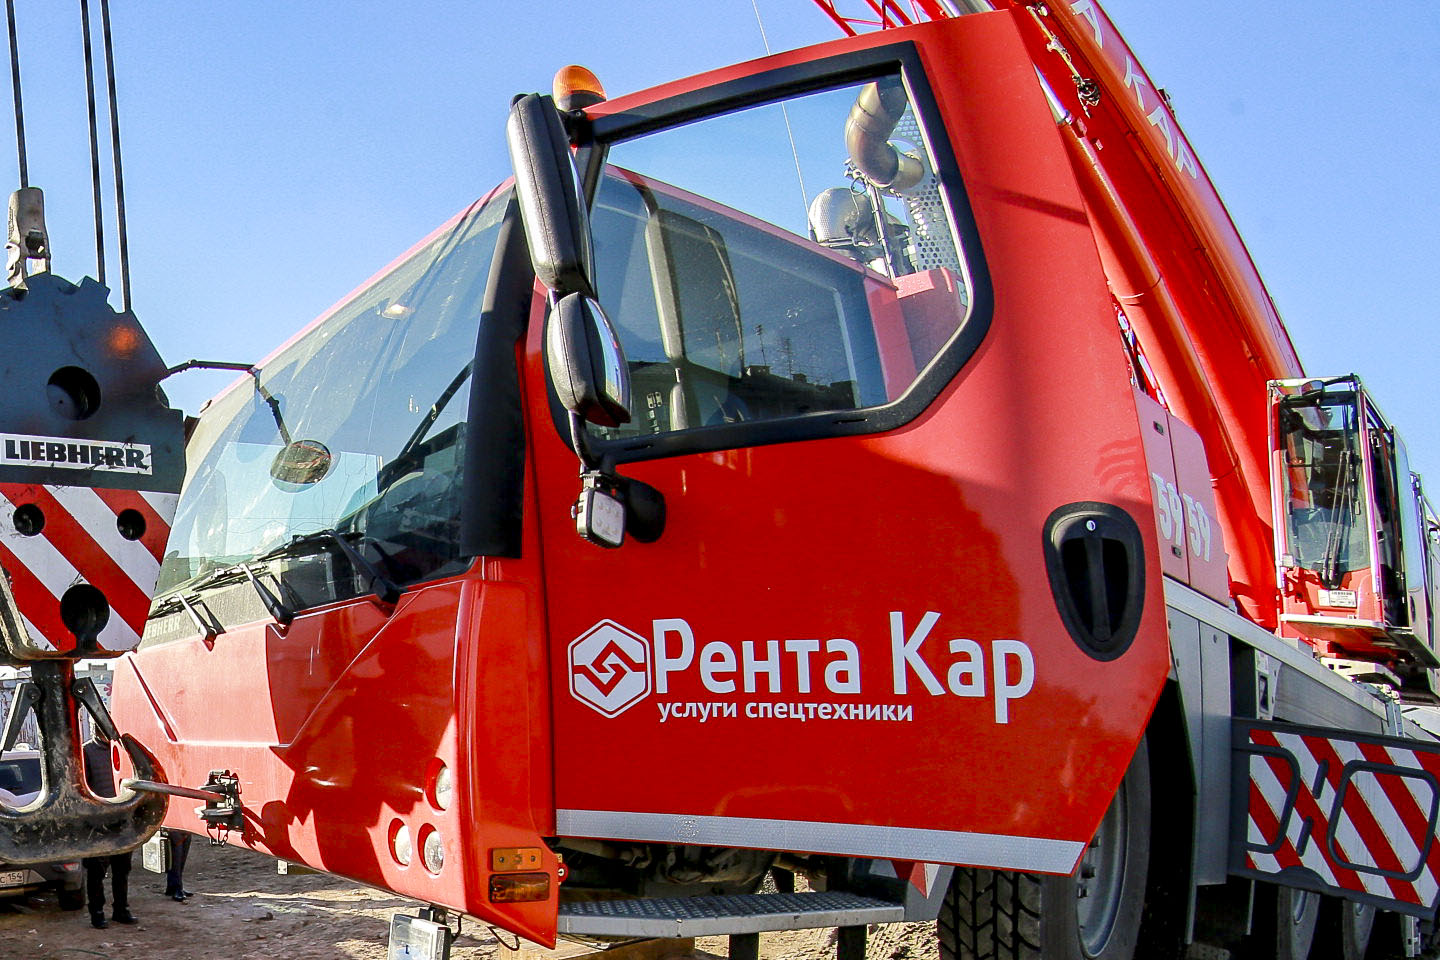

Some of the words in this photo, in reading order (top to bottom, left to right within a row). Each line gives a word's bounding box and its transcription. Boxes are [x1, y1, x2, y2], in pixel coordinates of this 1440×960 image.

[4, 439, 148, 470] LIEBHERR
[652, 618, 861, 694] Рента
[889, 611, 1035, 724] Кар
[657, 702, 737, 723] услуги
[745, 702, 913, 722] спецтехники
